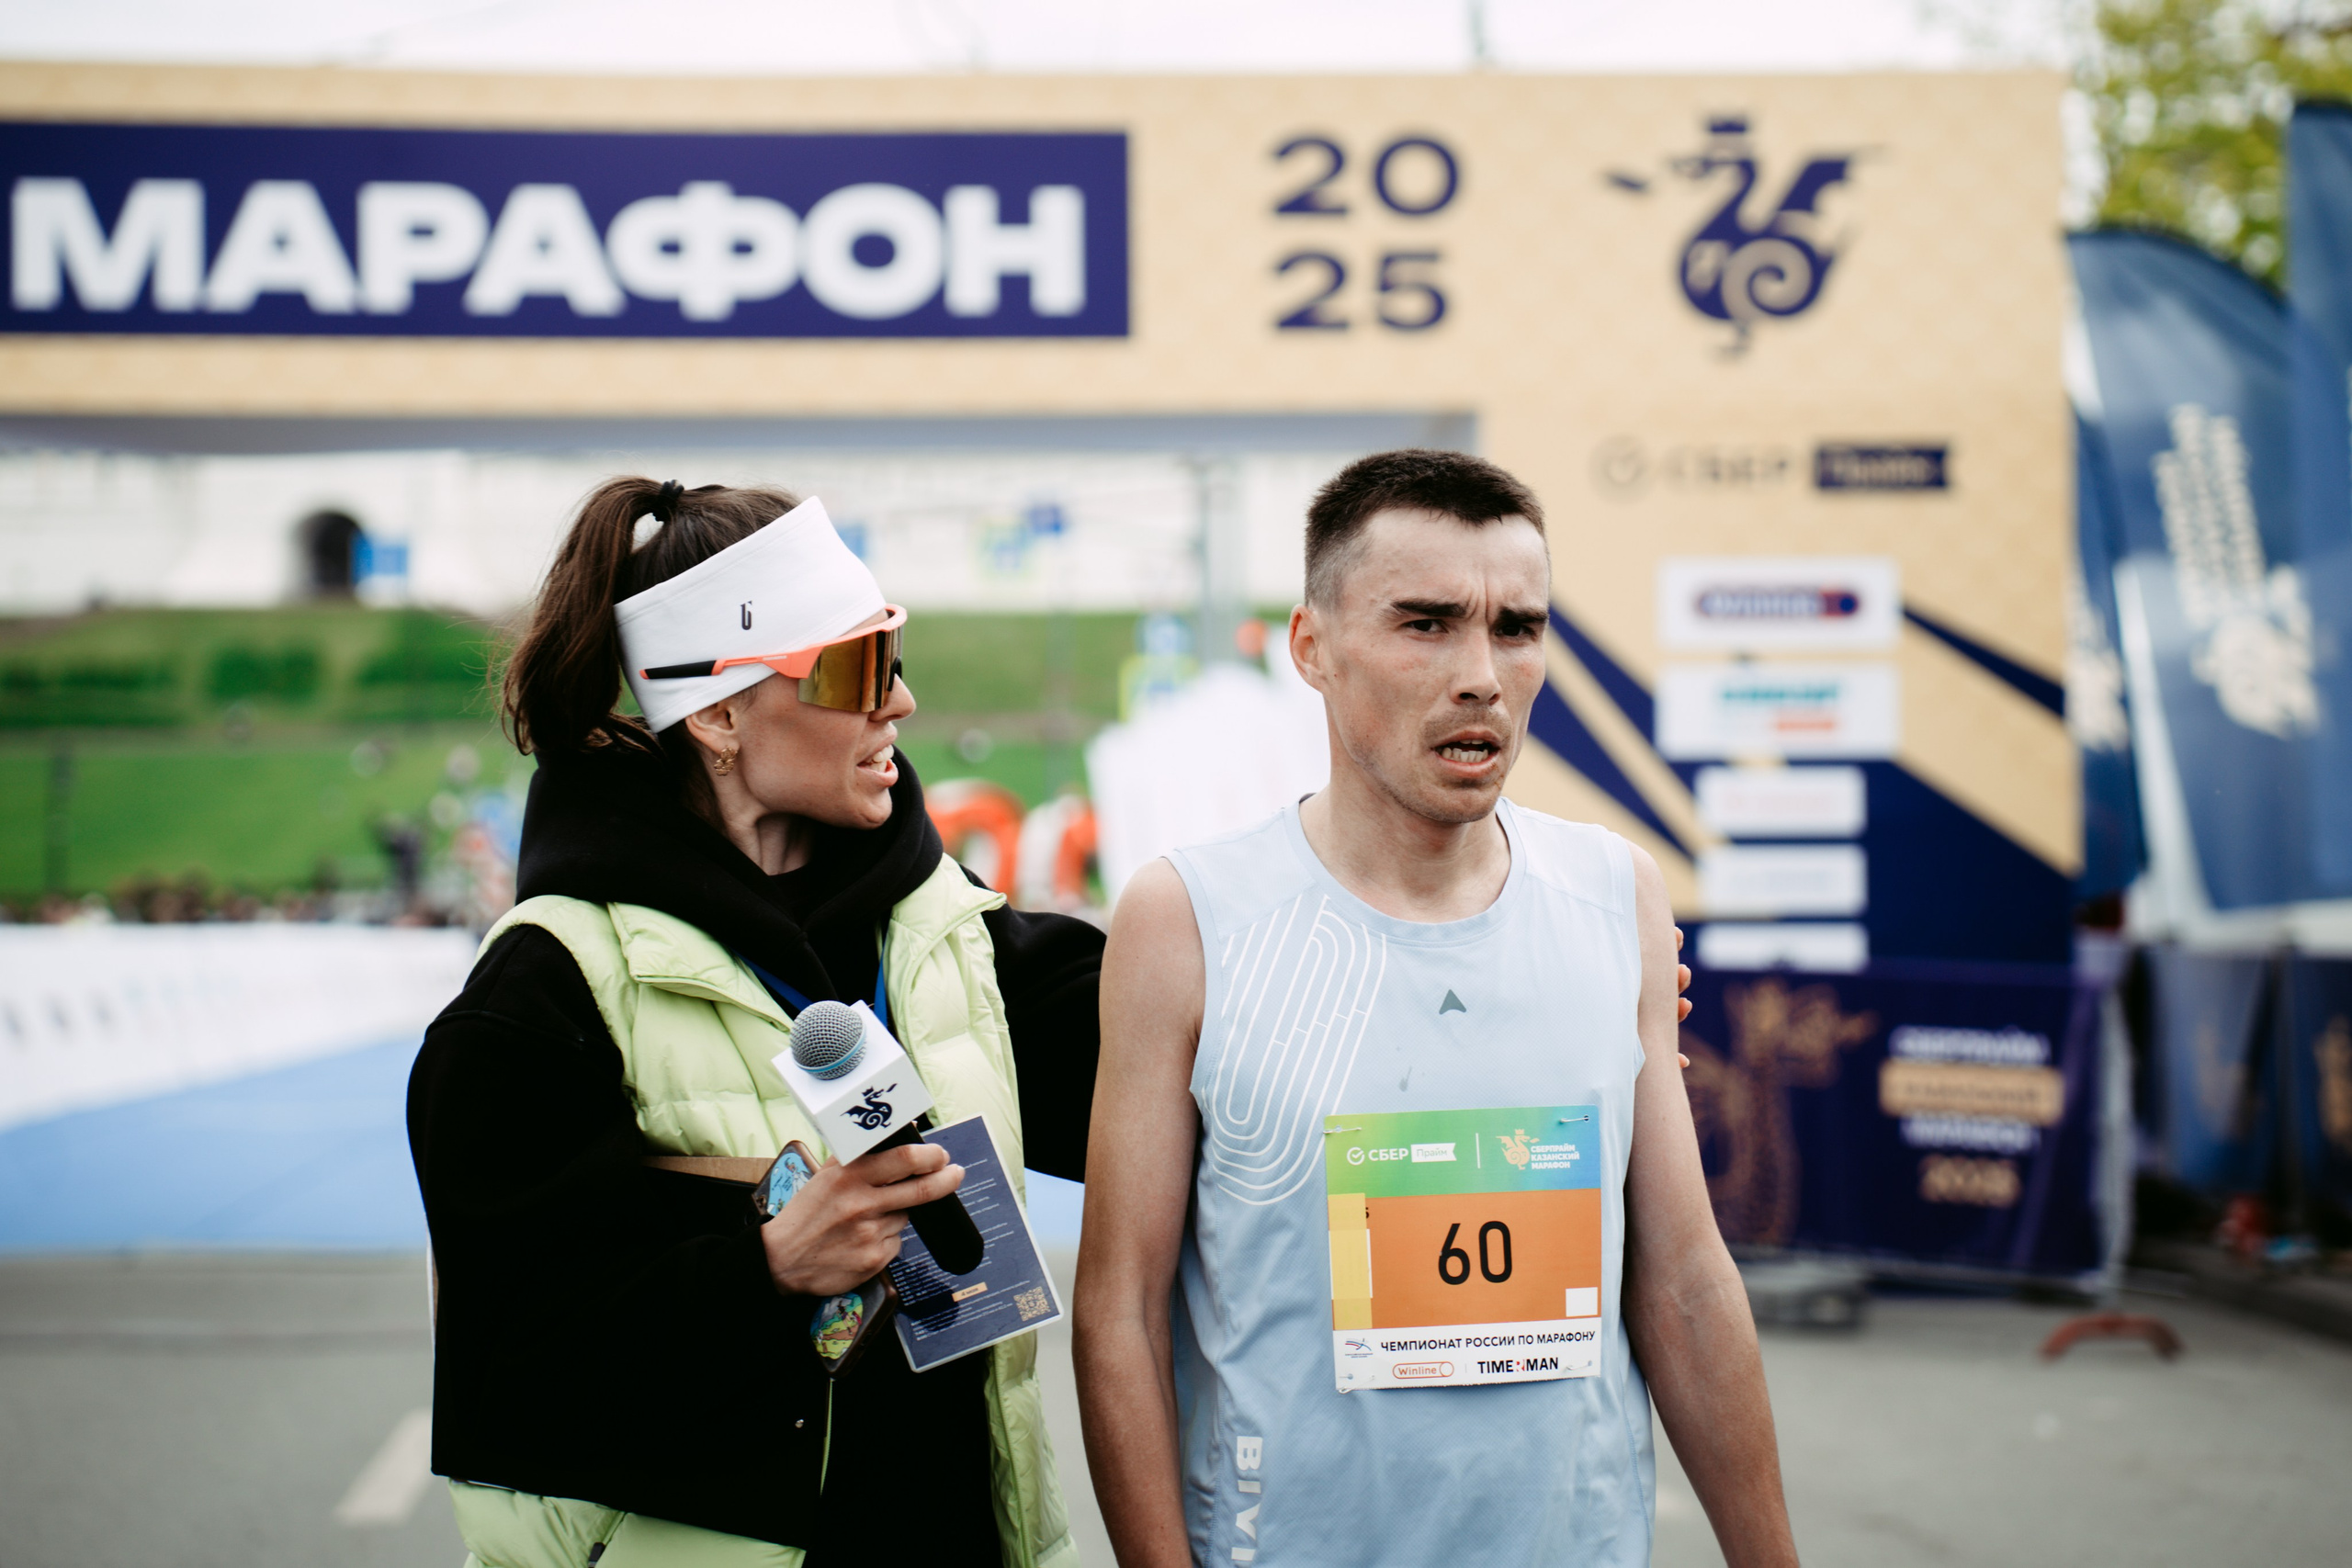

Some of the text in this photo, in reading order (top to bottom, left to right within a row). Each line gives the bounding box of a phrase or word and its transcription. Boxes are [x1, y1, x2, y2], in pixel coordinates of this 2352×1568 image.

[1272, 134, 1461, 218] 20
[12, 178, 1086, 320] МАРАФОН
[1272, 249, 1451, 332] 25
[1368, 1148, 1448, 1161] СБЕР Прайм
[1531, 1143, 1576, 1153] СБЕРПРАЙМ
[1531, 1151, 1580, 1161] КАЗАНСКИЙ
[1532, 1161, 1571, 1169] МАРАФОН
[1438, 1221, 1512, 1285] 60
[1381, 1331, 1596, 1352] ЧЕМПИОНАТ РОССИИ ПО МАРАФОНУ
[1397, 1366, 1437, 1375] Winline
